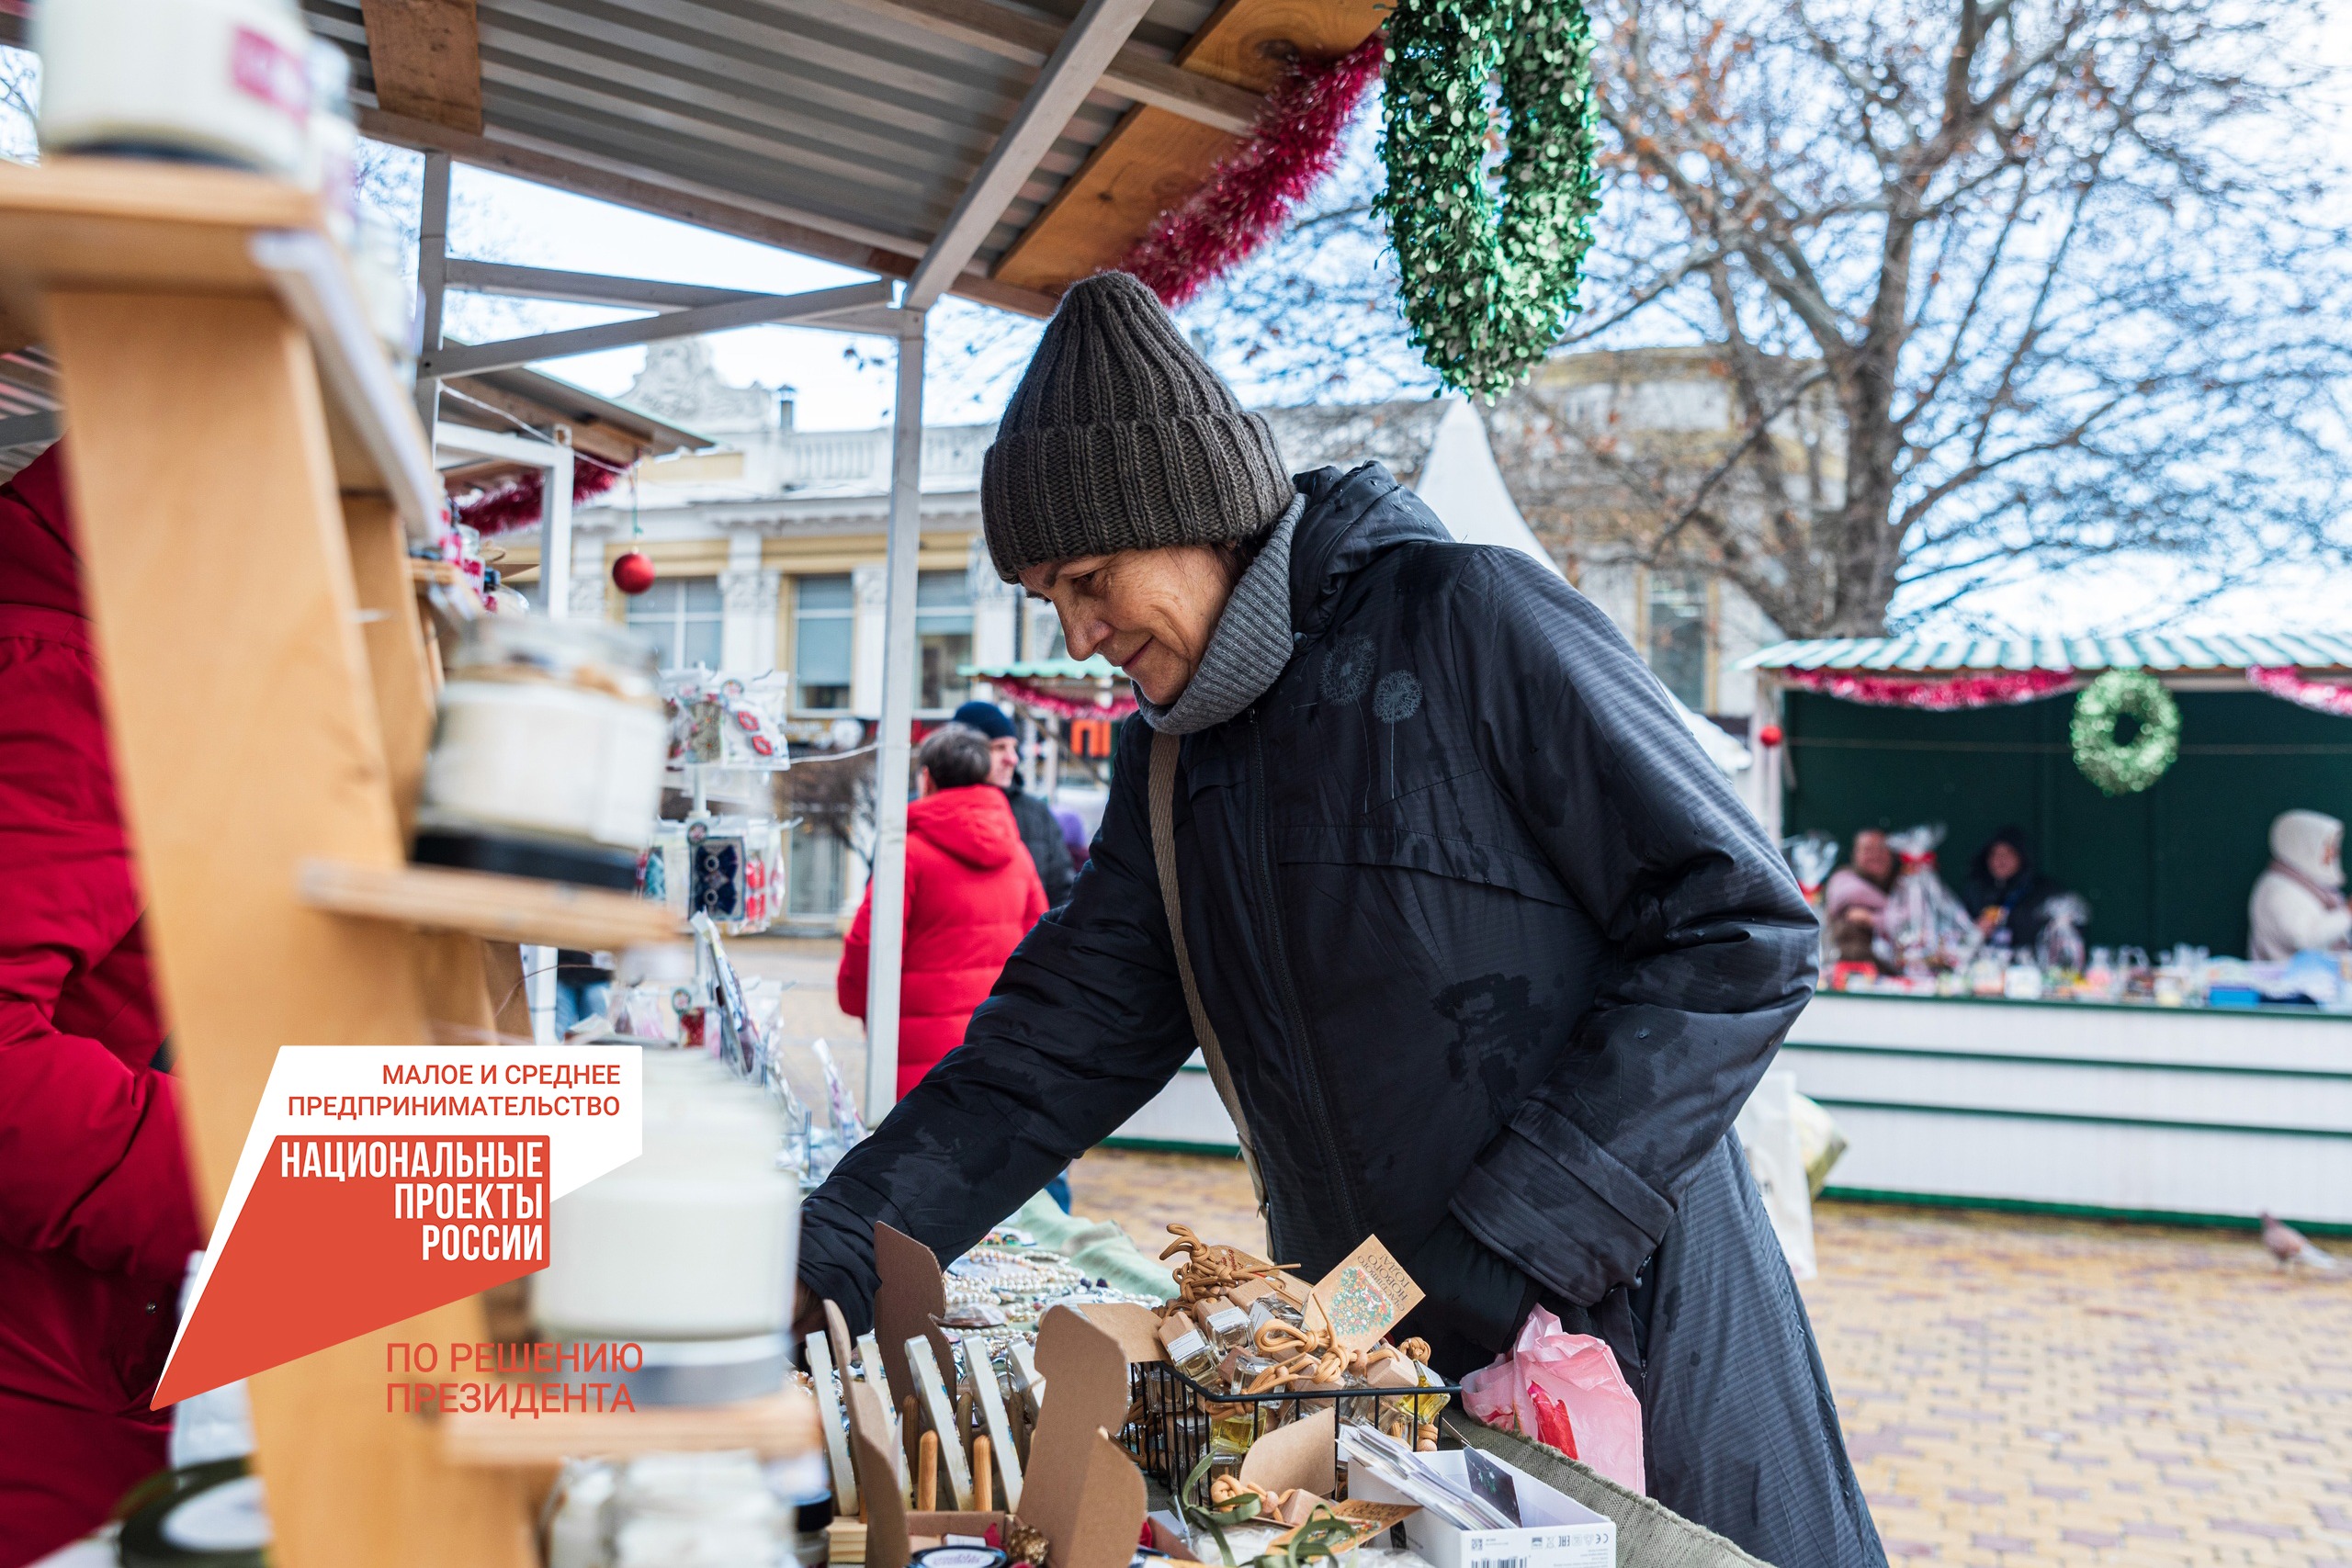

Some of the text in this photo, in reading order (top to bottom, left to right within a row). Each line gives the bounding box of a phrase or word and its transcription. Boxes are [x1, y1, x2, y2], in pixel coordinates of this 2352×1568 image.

[1358, 1256, 1405, 1311] СЧАСТЛИВОГО
[1368, 1255, 1408, 1301] НОВОГО
[1379, 1254, 1409, 1288] ГОДА!
